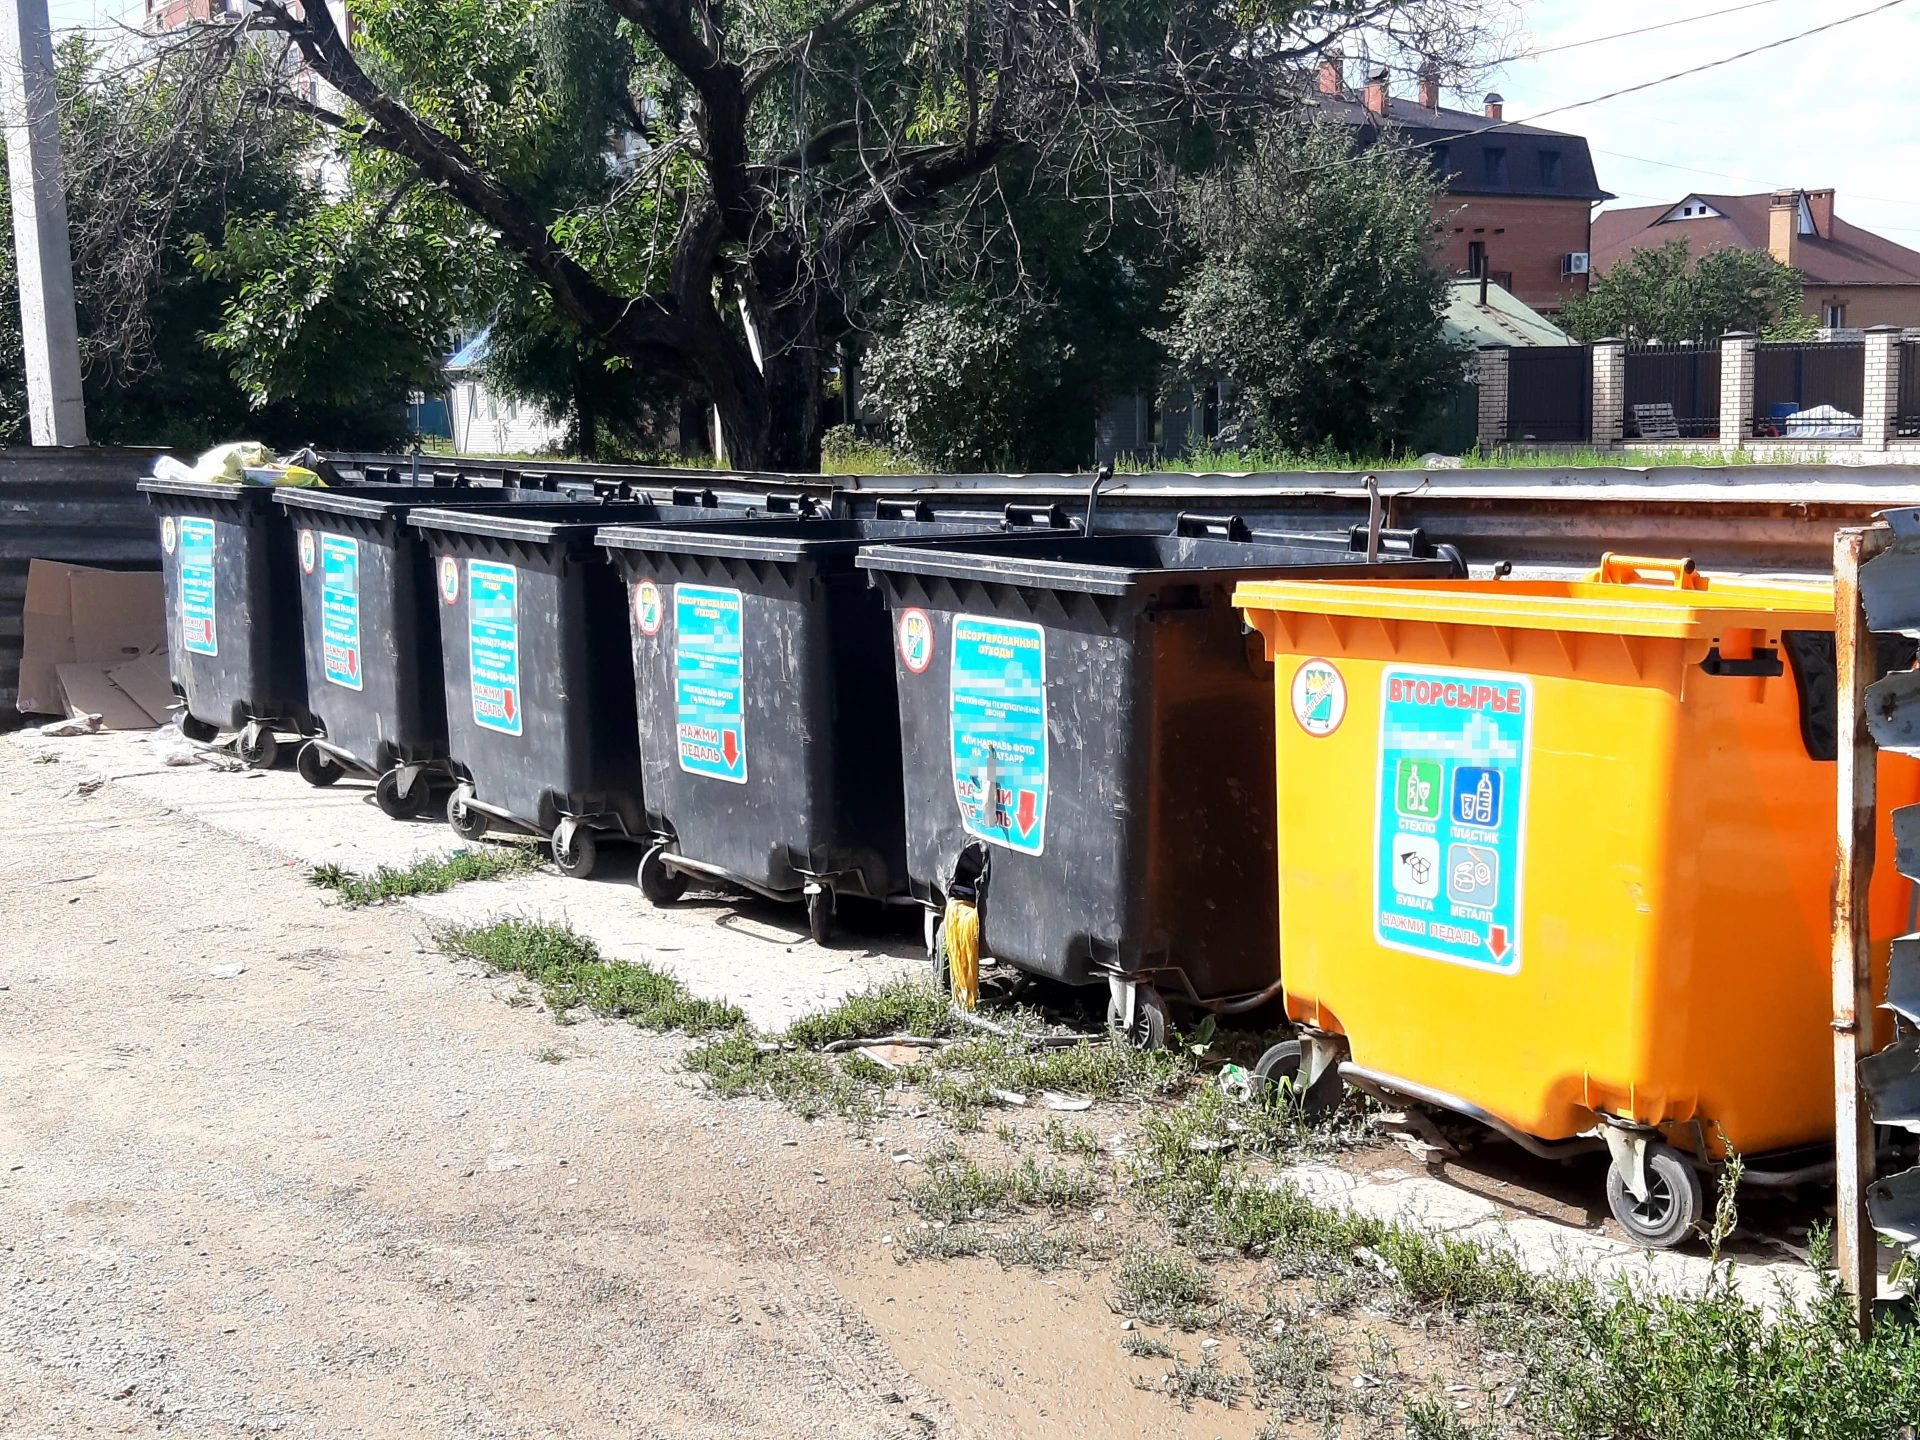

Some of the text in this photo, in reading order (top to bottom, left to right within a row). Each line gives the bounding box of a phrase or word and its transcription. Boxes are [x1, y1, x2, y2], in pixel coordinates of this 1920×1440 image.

[957, 629, 1039, 650] НЕСОРТИРОВАННЫЕ
[978, 645, 1014, 659] ОТХОДЫ
[474, 683, 501, 701] НАЖМИ
[1300, 674, 1338, 721] ЗАПРЕЩЕНО!
[1389, 678, 1521, 714] ВТОРСЫРЬЕ
[474, 699, 502, 718] ПЕДАЛЬ
[985, 708, 1006, 719] ЗВОНИ
[681, 724, 719, 744] НАЖМИ
[681, 742, 721, 763] ПЕДАЛЬ
[961, 735, 977, 746] ИЛИ
[1013, 743, 1036, 755] ФОТО
[972, 747, 982, 756] НА
[1398, 818, 1499, 844] СТЕКЛО ПЛАСТИК
[1396, 894, 1493, 922] БУМАГА МЕТАЛЛ
[1382, 913, 1481, 945] НАЖМИ ПЕДАЛЬ
